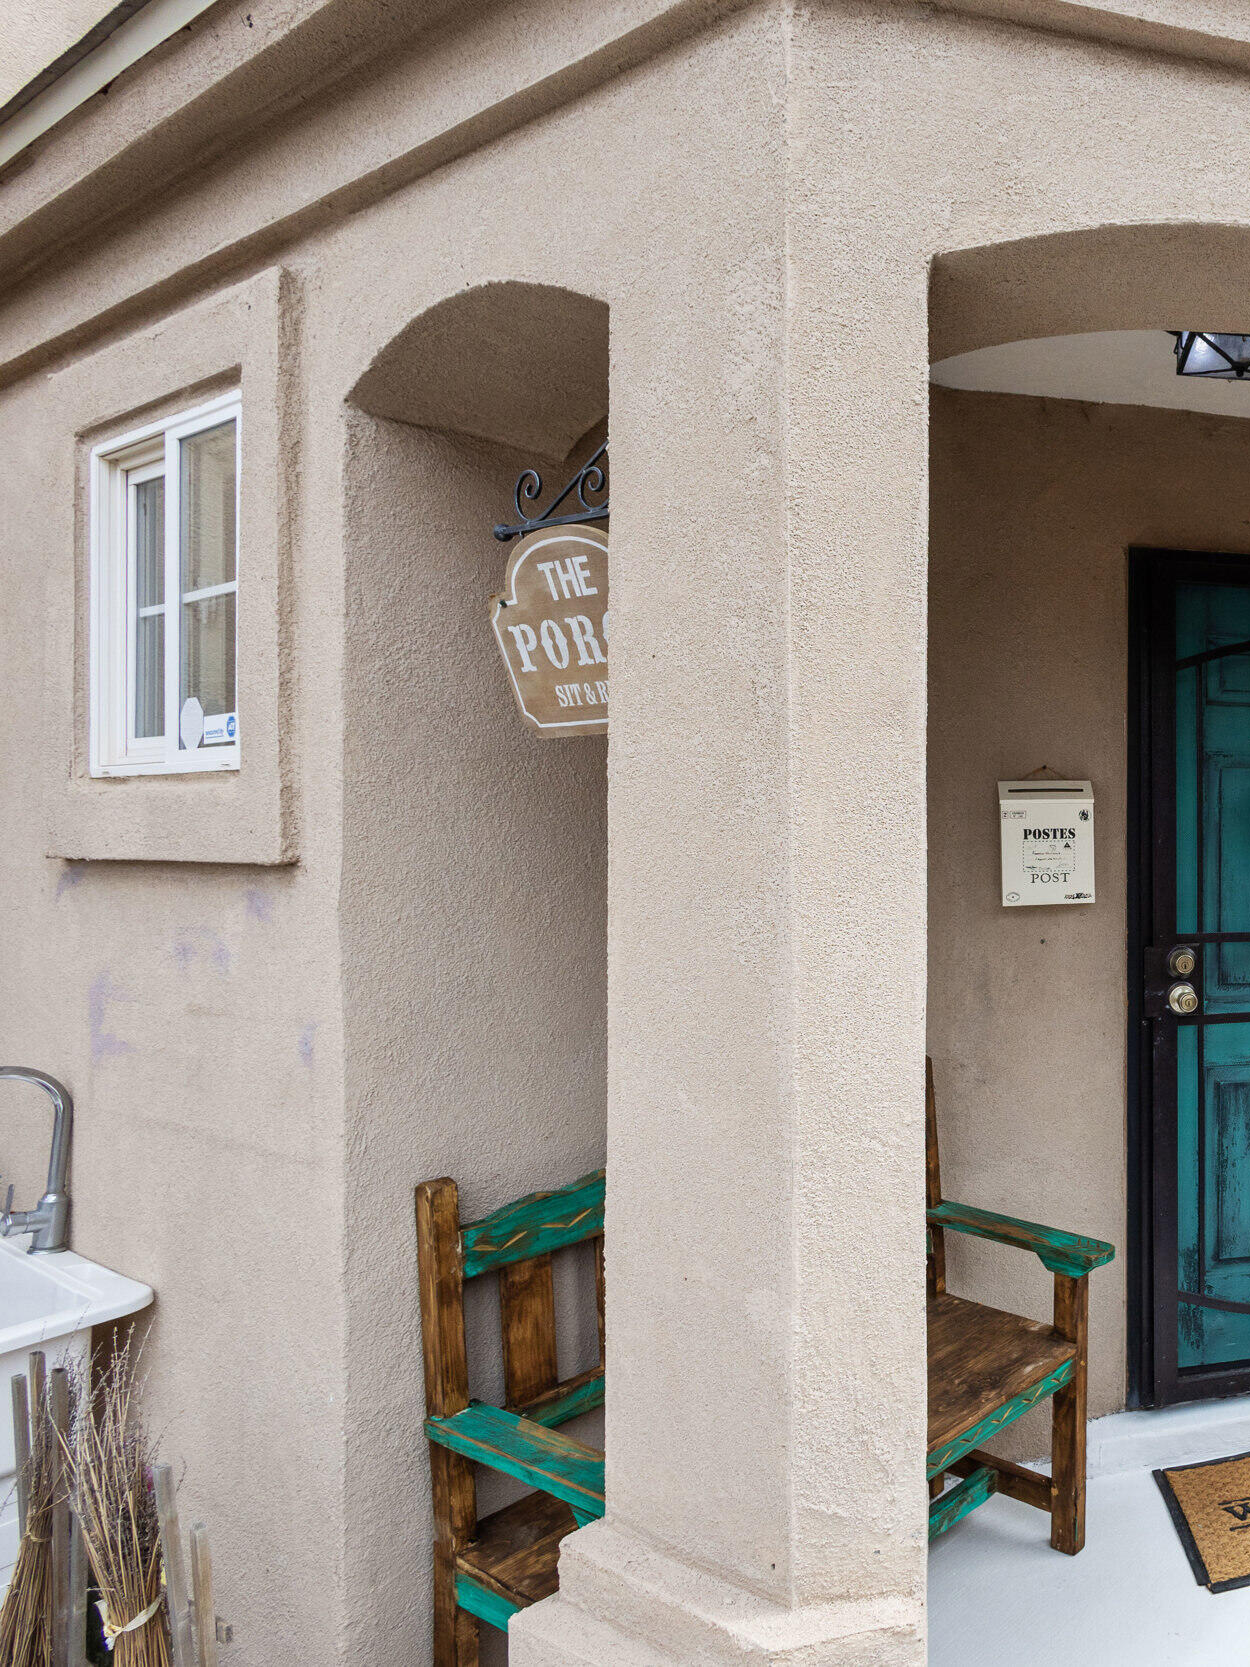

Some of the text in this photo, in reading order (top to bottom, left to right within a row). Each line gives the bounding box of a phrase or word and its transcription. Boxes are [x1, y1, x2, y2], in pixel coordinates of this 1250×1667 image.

[537, 555, 598, 601] THE
[555, 684, 584, 708] SIT
[583, 682, 596, 705] &
[1023, 828, 1076, 840] POSTES
[1031, 872, 1071, 884] POST
